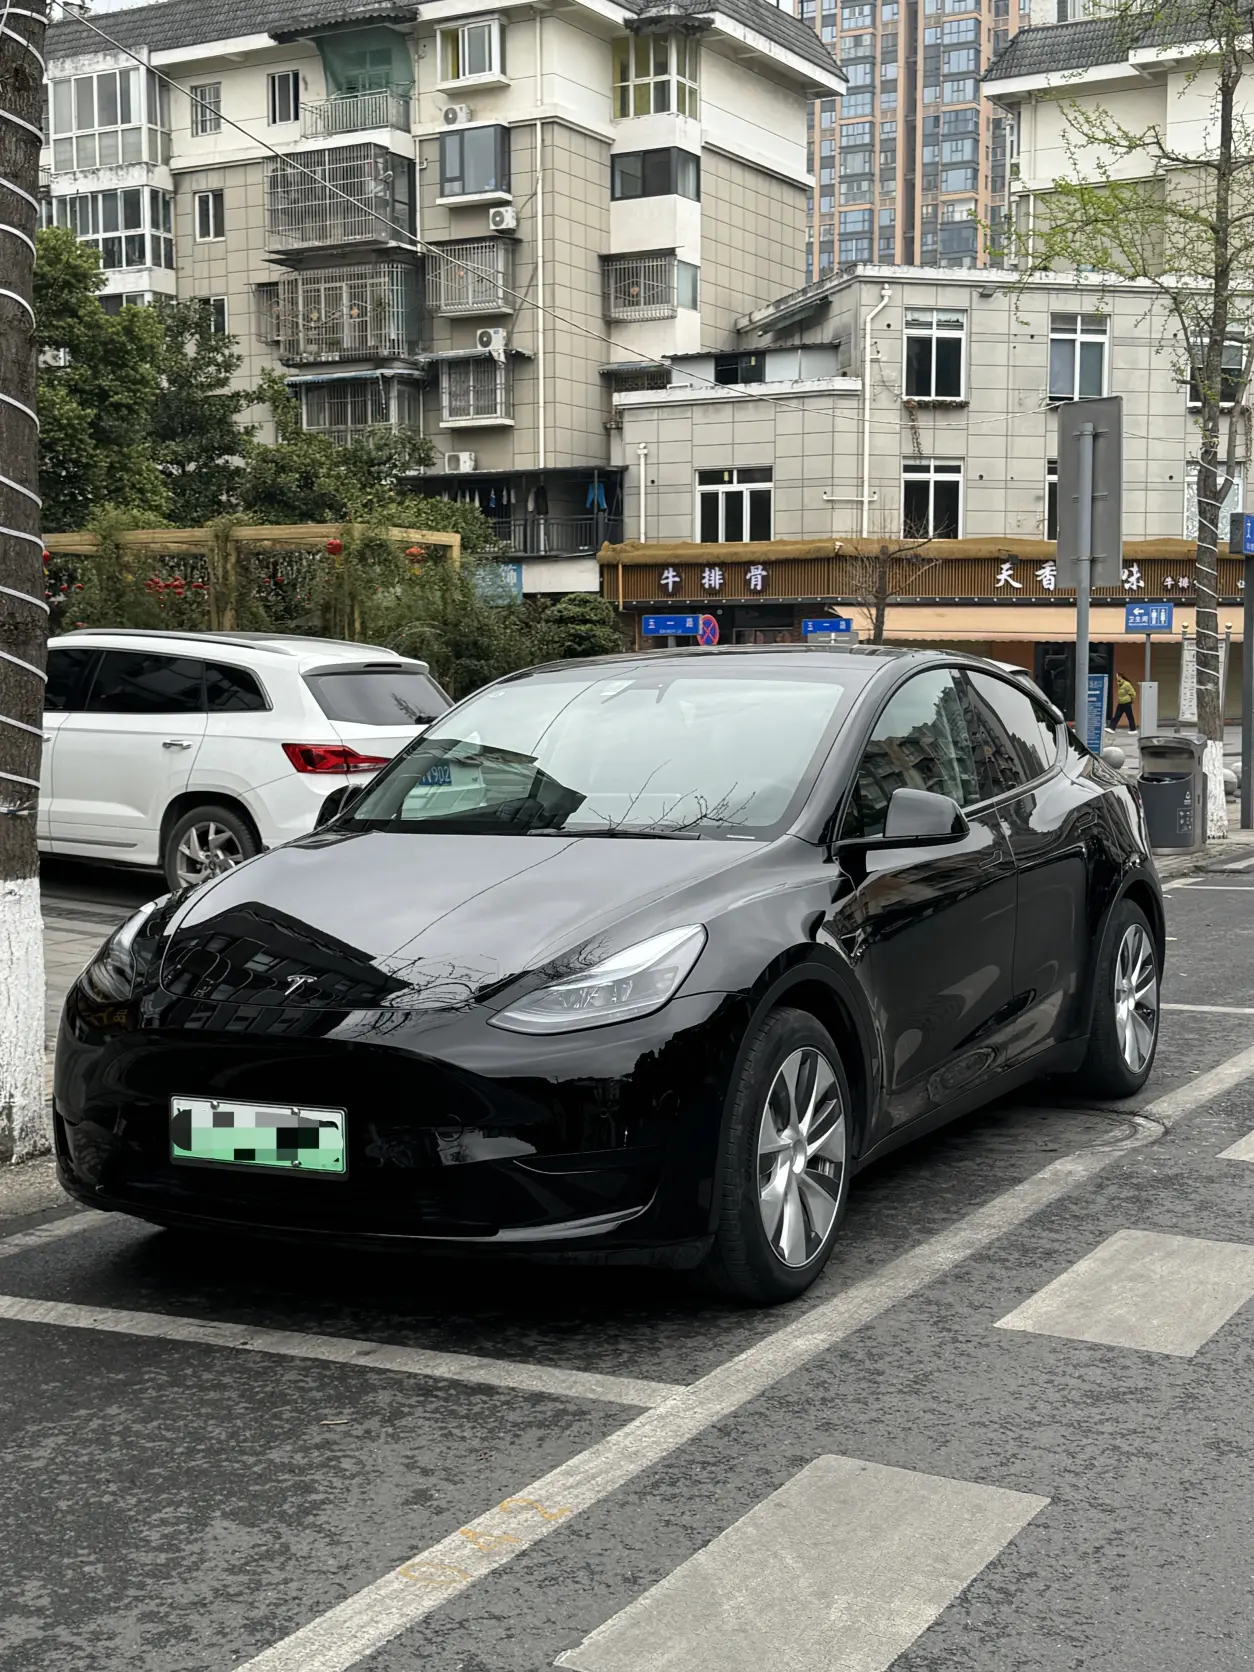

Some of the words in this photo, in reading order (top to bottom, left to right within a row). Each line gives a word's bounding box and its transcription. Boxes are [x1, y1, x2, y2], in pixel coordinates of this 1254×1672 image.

[660, 564, 768, 592] 牛排骨
[995, 561, 1145, 590] 天香味
[1163, 577, 1198, 589] 牛排
